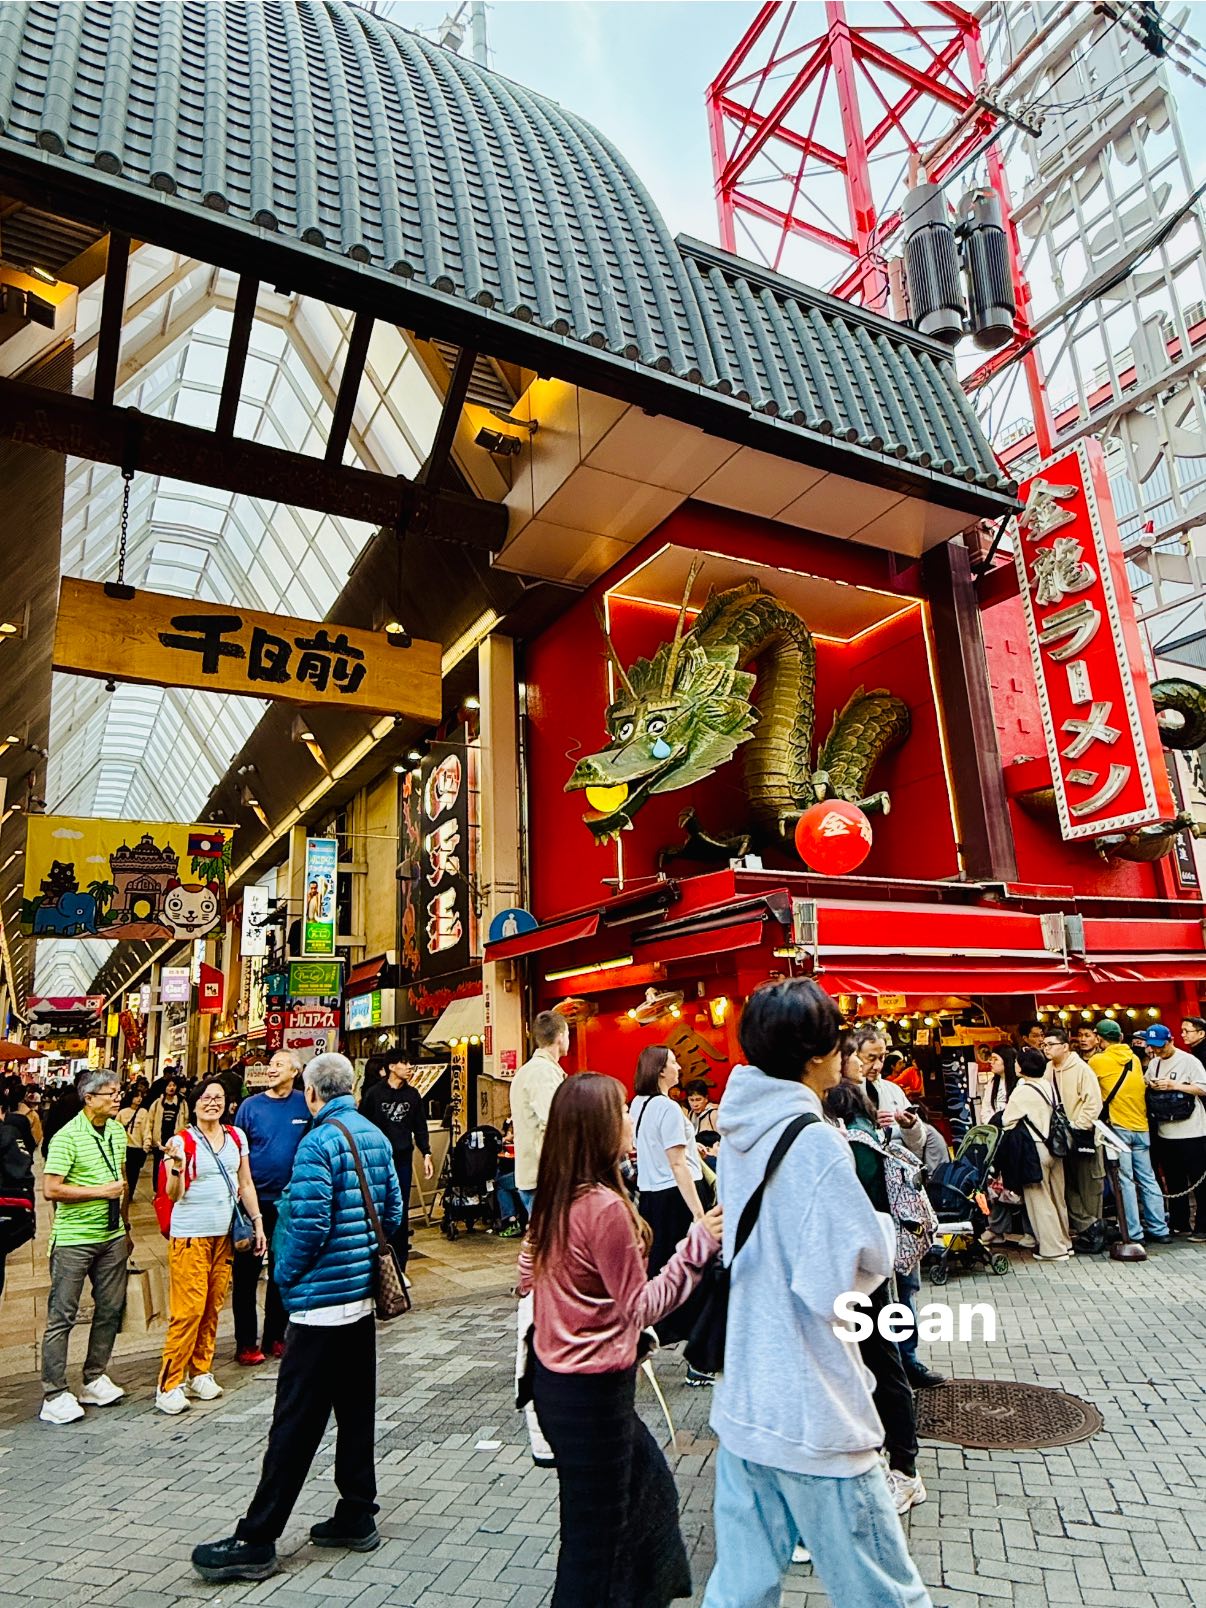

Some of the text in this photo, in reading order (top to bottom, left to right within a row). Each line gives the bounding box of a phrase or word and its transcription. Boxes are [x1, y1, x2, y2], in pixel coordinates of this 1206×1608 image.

[158, 613, 367, 695] 千日前
[1016, 475, 1132, 818] 金龍ラーメン
[289, 1013, 336, 1028] トルコアイス
